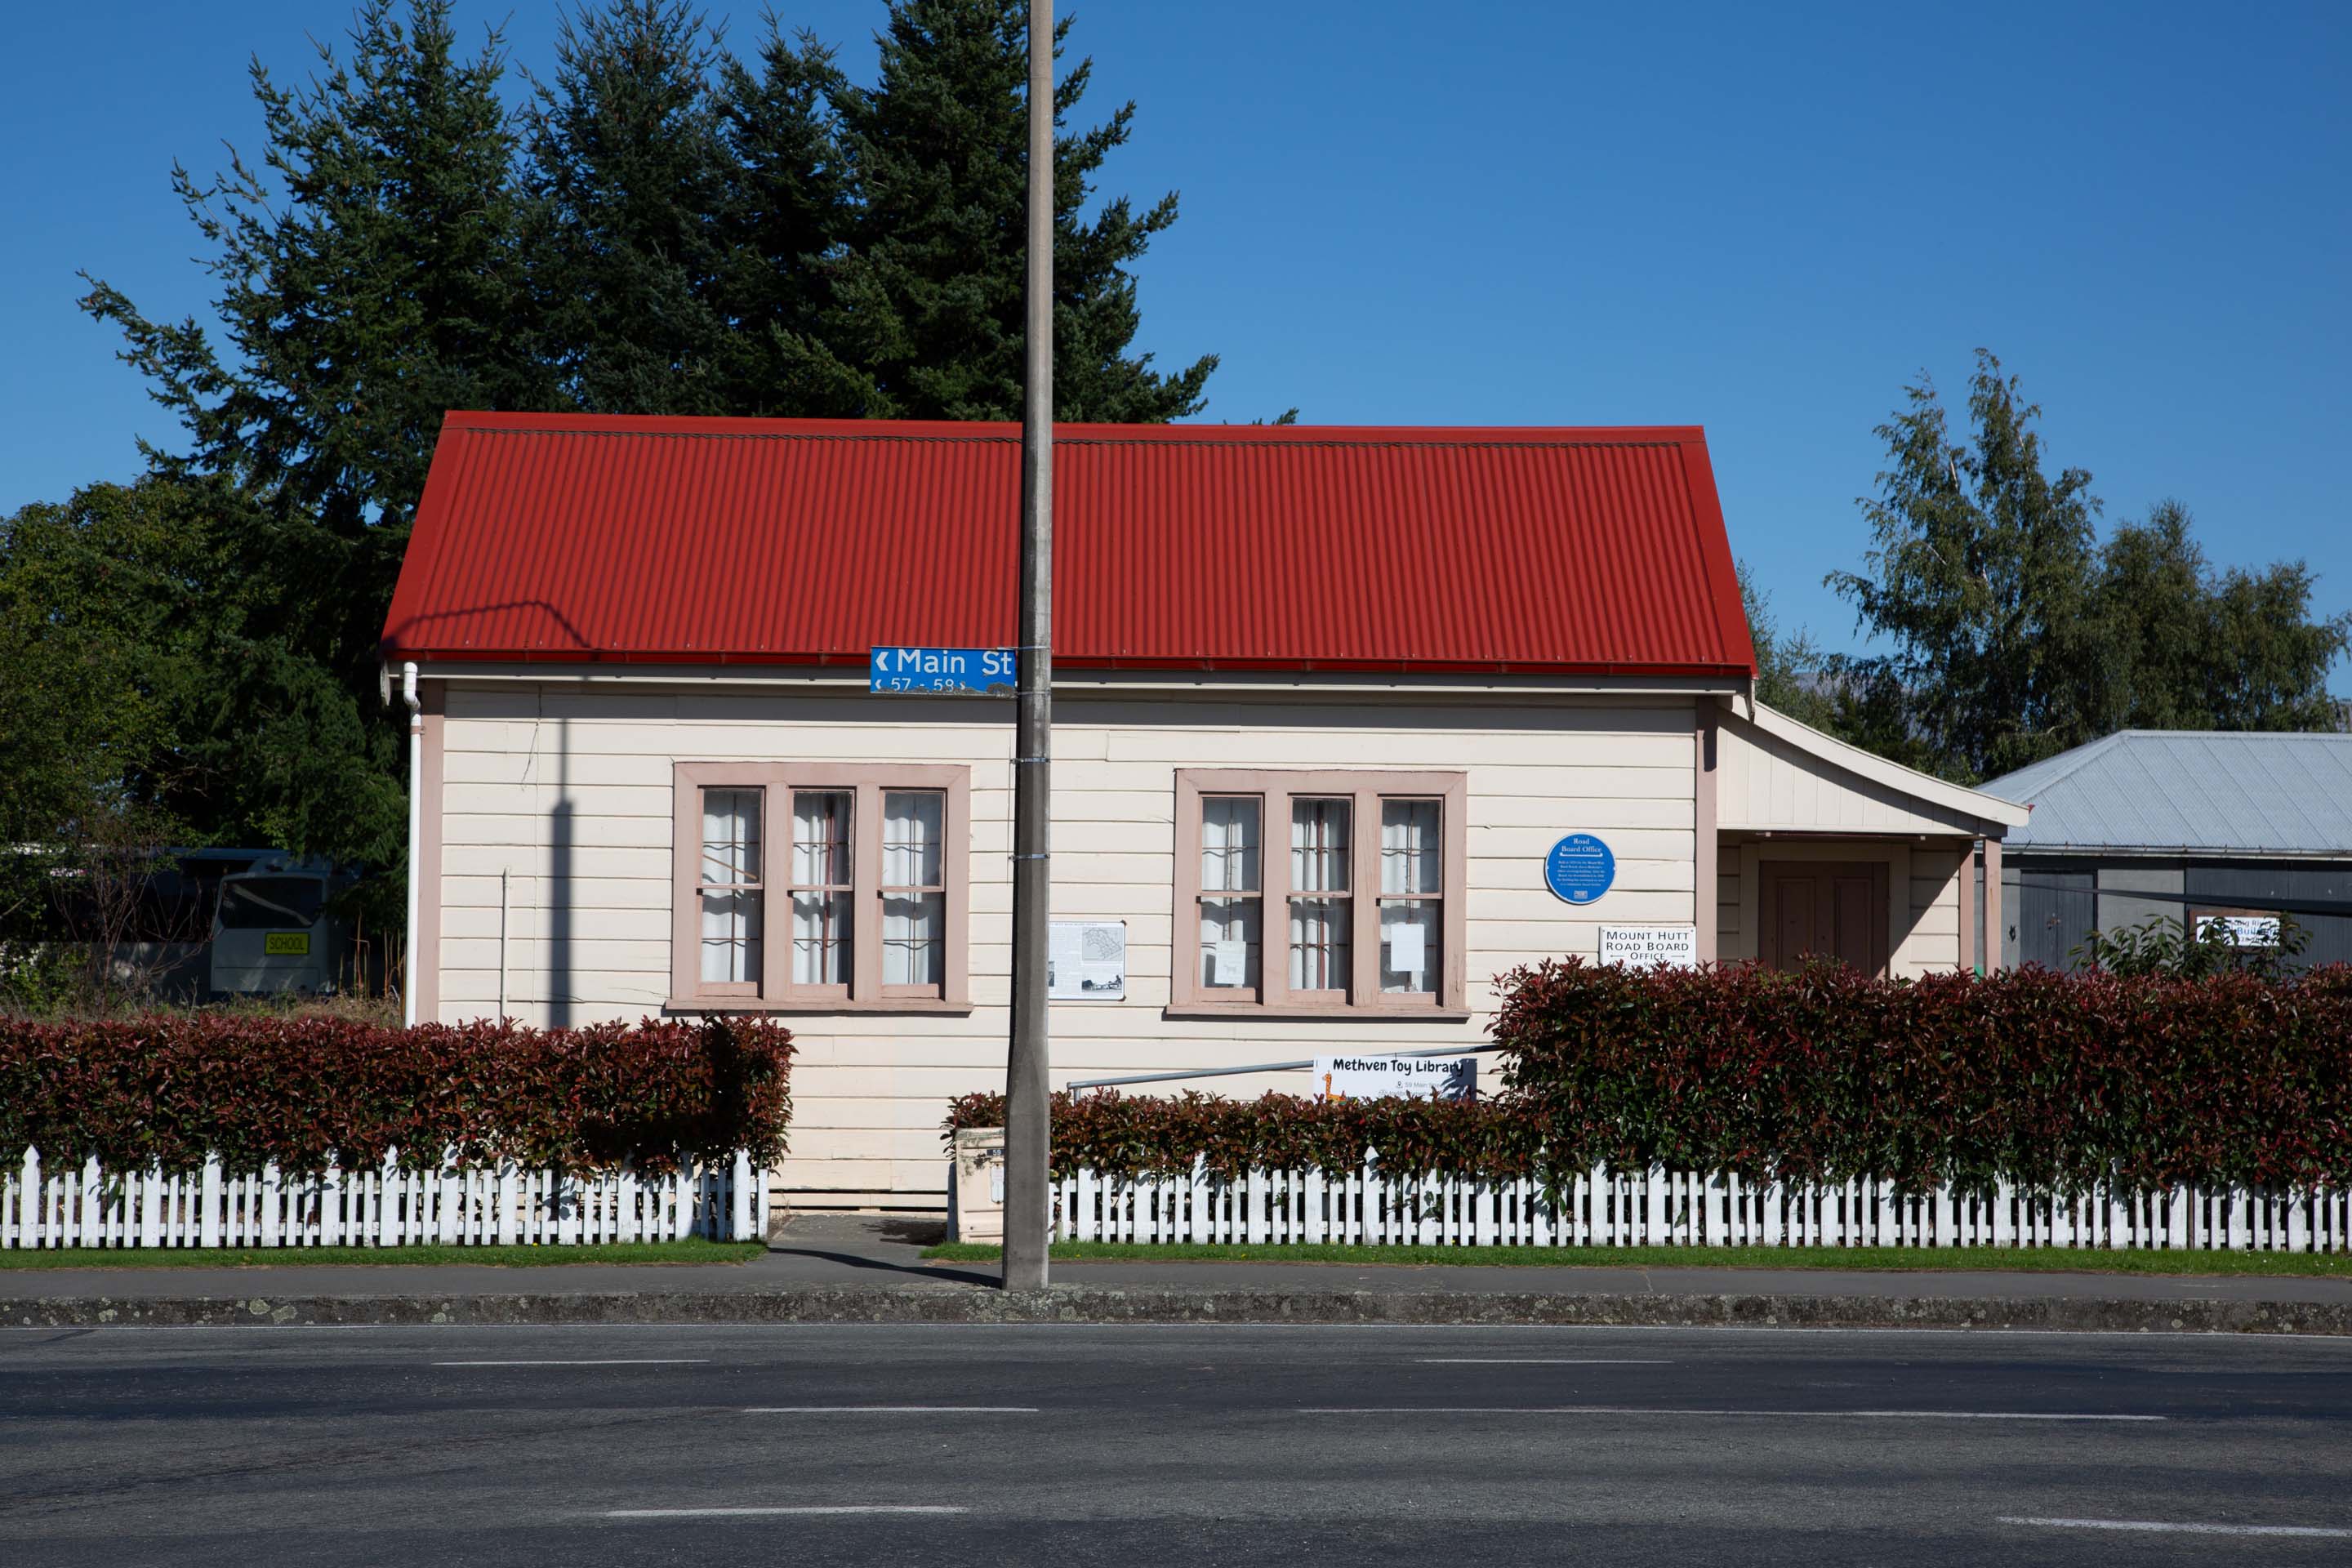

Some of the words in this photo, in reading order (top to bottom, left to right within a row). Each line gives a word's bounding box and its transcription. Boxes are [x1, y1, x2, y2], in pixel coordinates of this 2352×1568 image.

[898, 648, 965, 674] Main
[982, 651, 1012, 675] St
[891, 677, 911, 692] 57
[1606, 931, 1651, 941] MOUNT
[1658, 932, 1690, 941] HUTT
[270, 937, 305, 950] SCHOOL
[1606, 942, 1641, 951] ROAD
[1647, 942, 1689, 951] BOARD
[1630, 952, 1665, 960] OFFICE
[1333, 1058, 1388, 1071] Methven
[1391, 1060, 1412, 1076] Toy
[1416, 1060, 1463, 1077] Library
